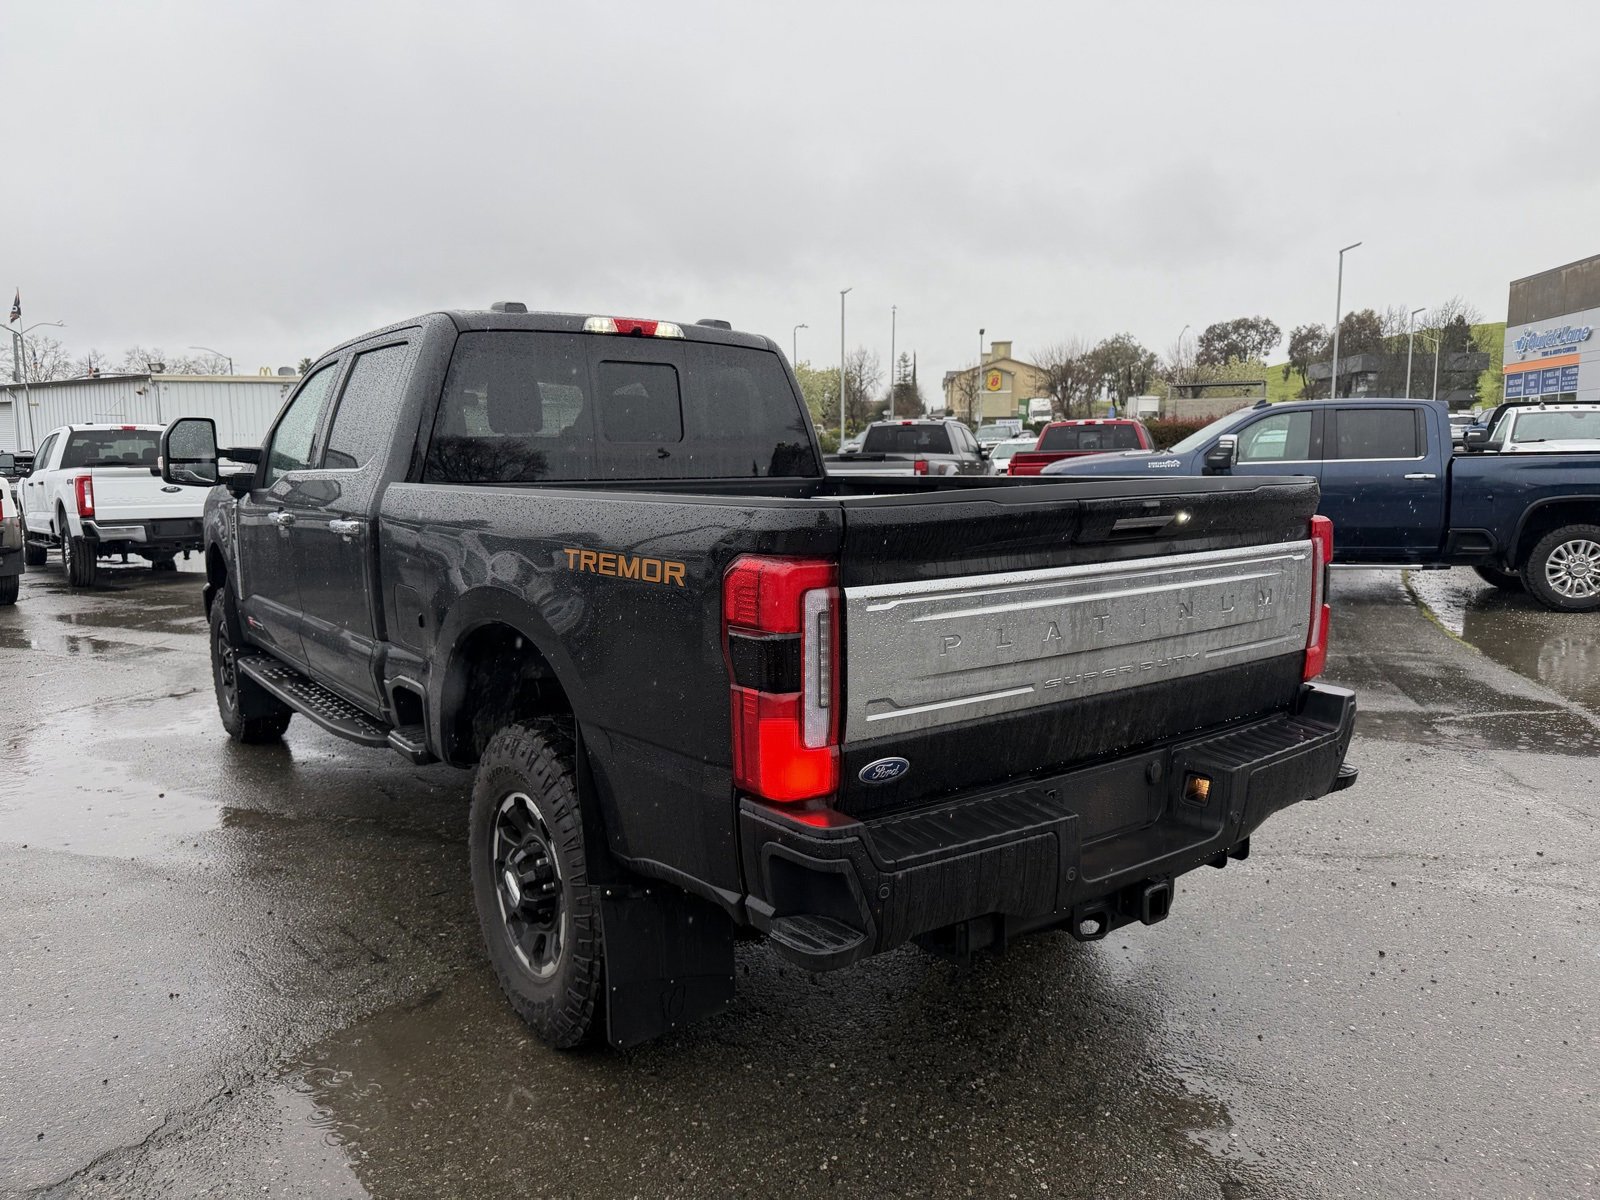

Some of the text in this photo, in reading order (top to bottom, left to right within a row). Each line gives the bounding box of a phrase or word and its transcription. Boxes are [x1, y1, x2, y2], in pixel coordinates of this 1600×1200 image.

[1527, 325, 1590, 352] Quick Lane
[563, 548, 687, 587] TREMOR
[939, 587, 1273, 657] PLATINUM
[1044, 652, 1200, 690] SUPER DUTY
